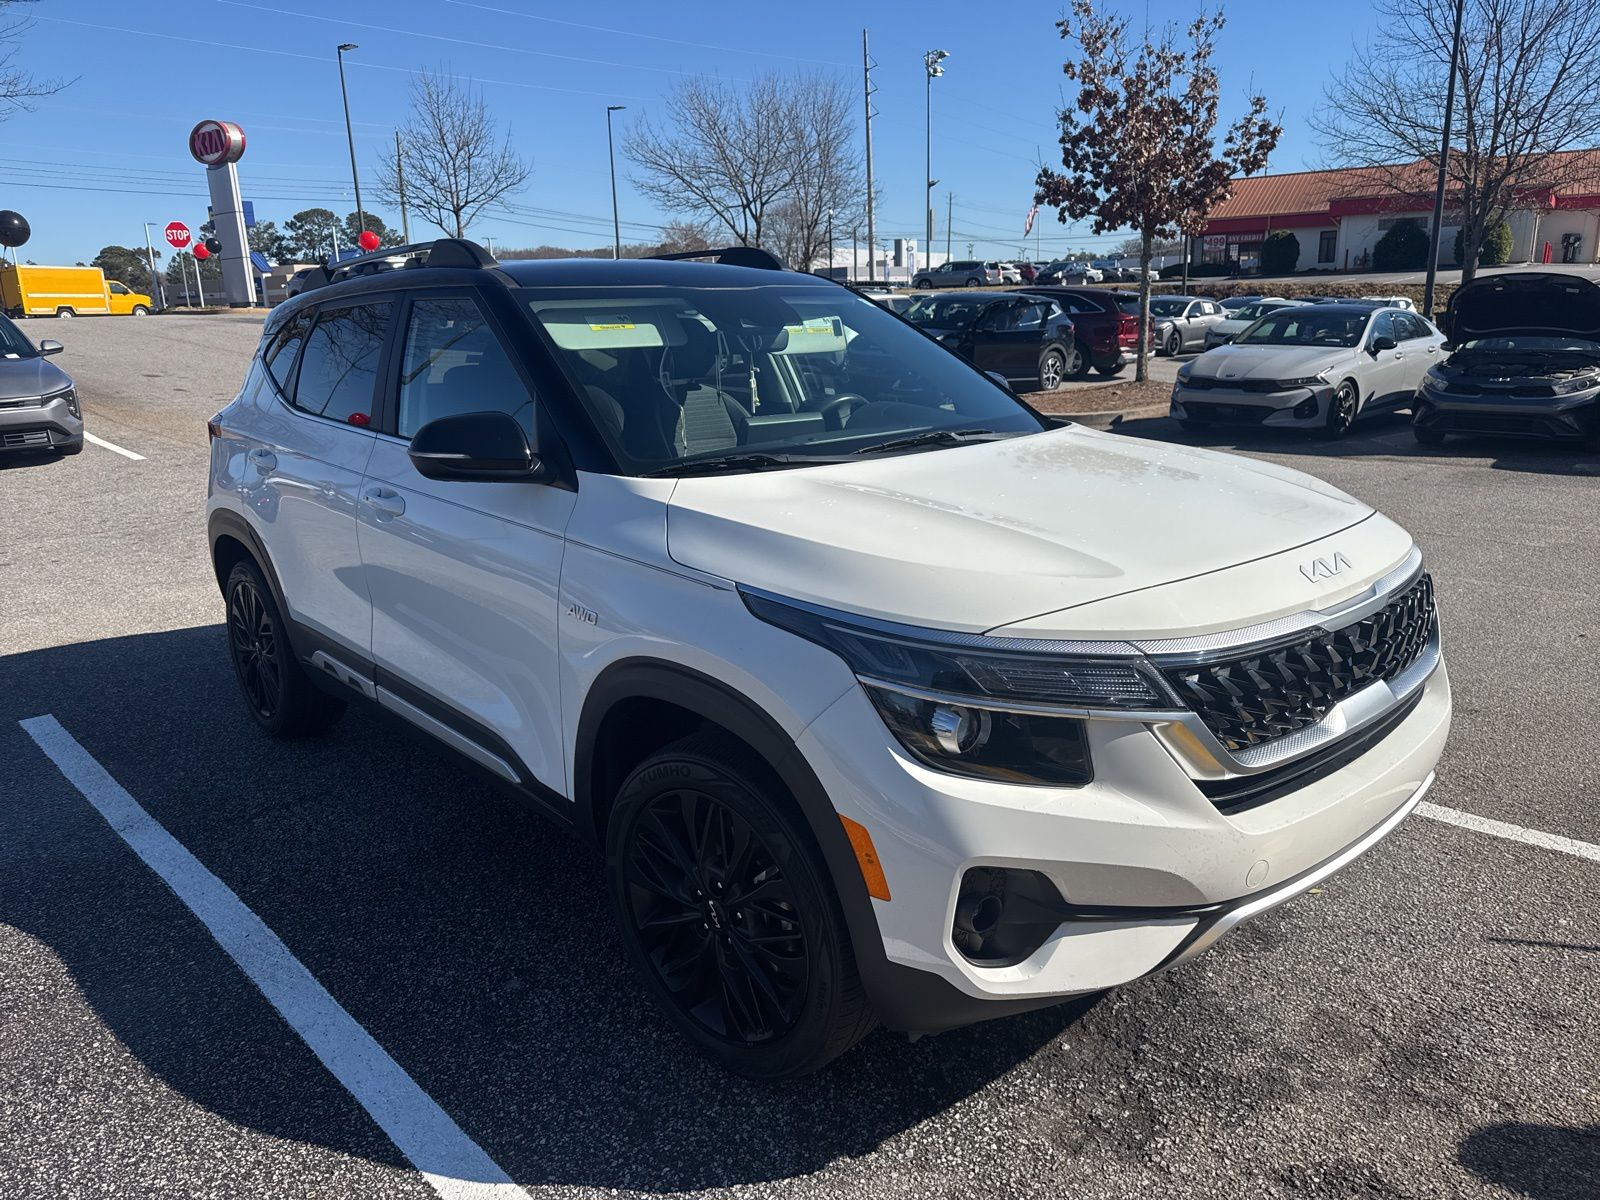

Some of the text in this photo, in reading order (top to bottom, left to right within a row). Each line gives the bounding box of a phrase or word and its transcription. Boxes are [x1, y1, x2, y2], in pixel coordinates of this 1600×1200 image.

[194, 129, 224, 156] KIA
[167, 230, 189, 240] STOP
[1299, 552, 1352, 583] KIA
[567, 604, 598, 625] AWD
[640, 765, 691, 785] KUMHO
